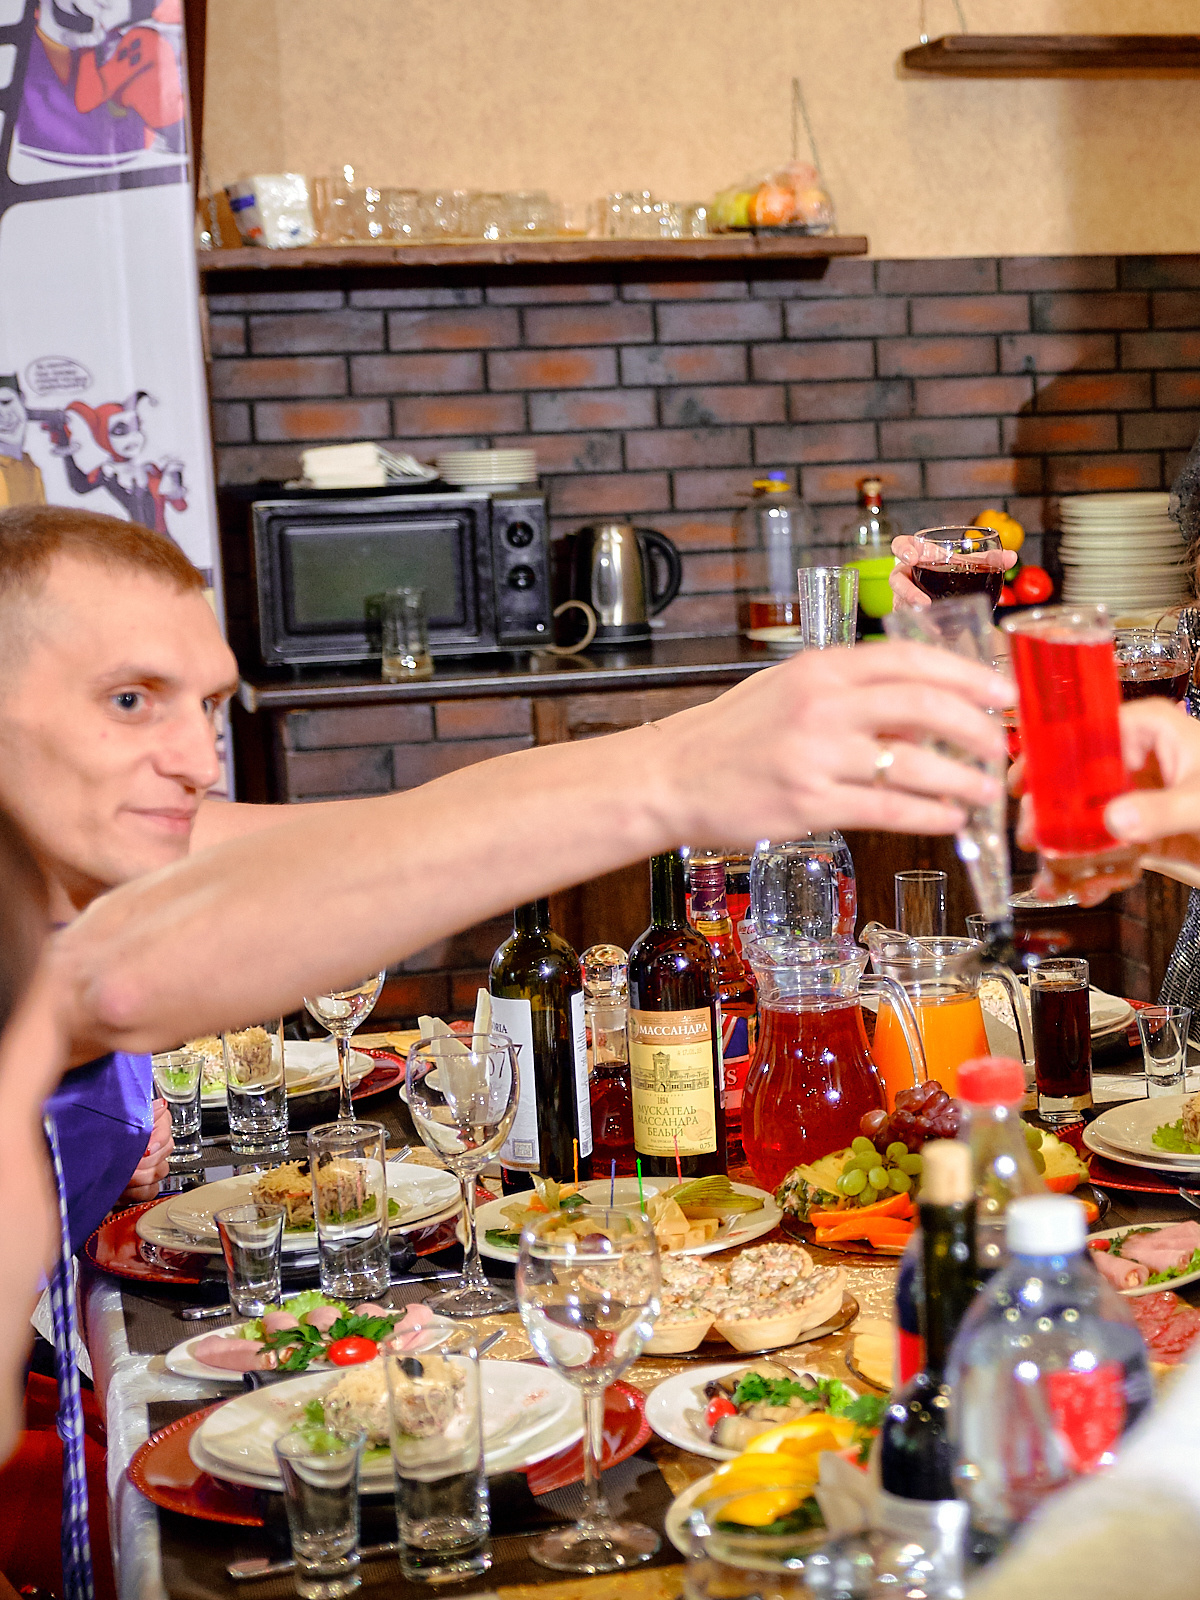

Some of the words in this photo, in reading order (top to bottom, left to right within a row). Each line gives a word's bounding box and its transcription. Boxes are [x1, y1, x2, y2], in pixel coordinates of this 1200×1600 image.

[639, 1022, 708, 1036] МАССАНДРА
[638, 1105, 697, 1116] МУСКАТЕЛЬ
[637, 1115, 699, 1127] МАССАНДРА
[647, 1125, 684, 1137] БЕЛЫЙ
